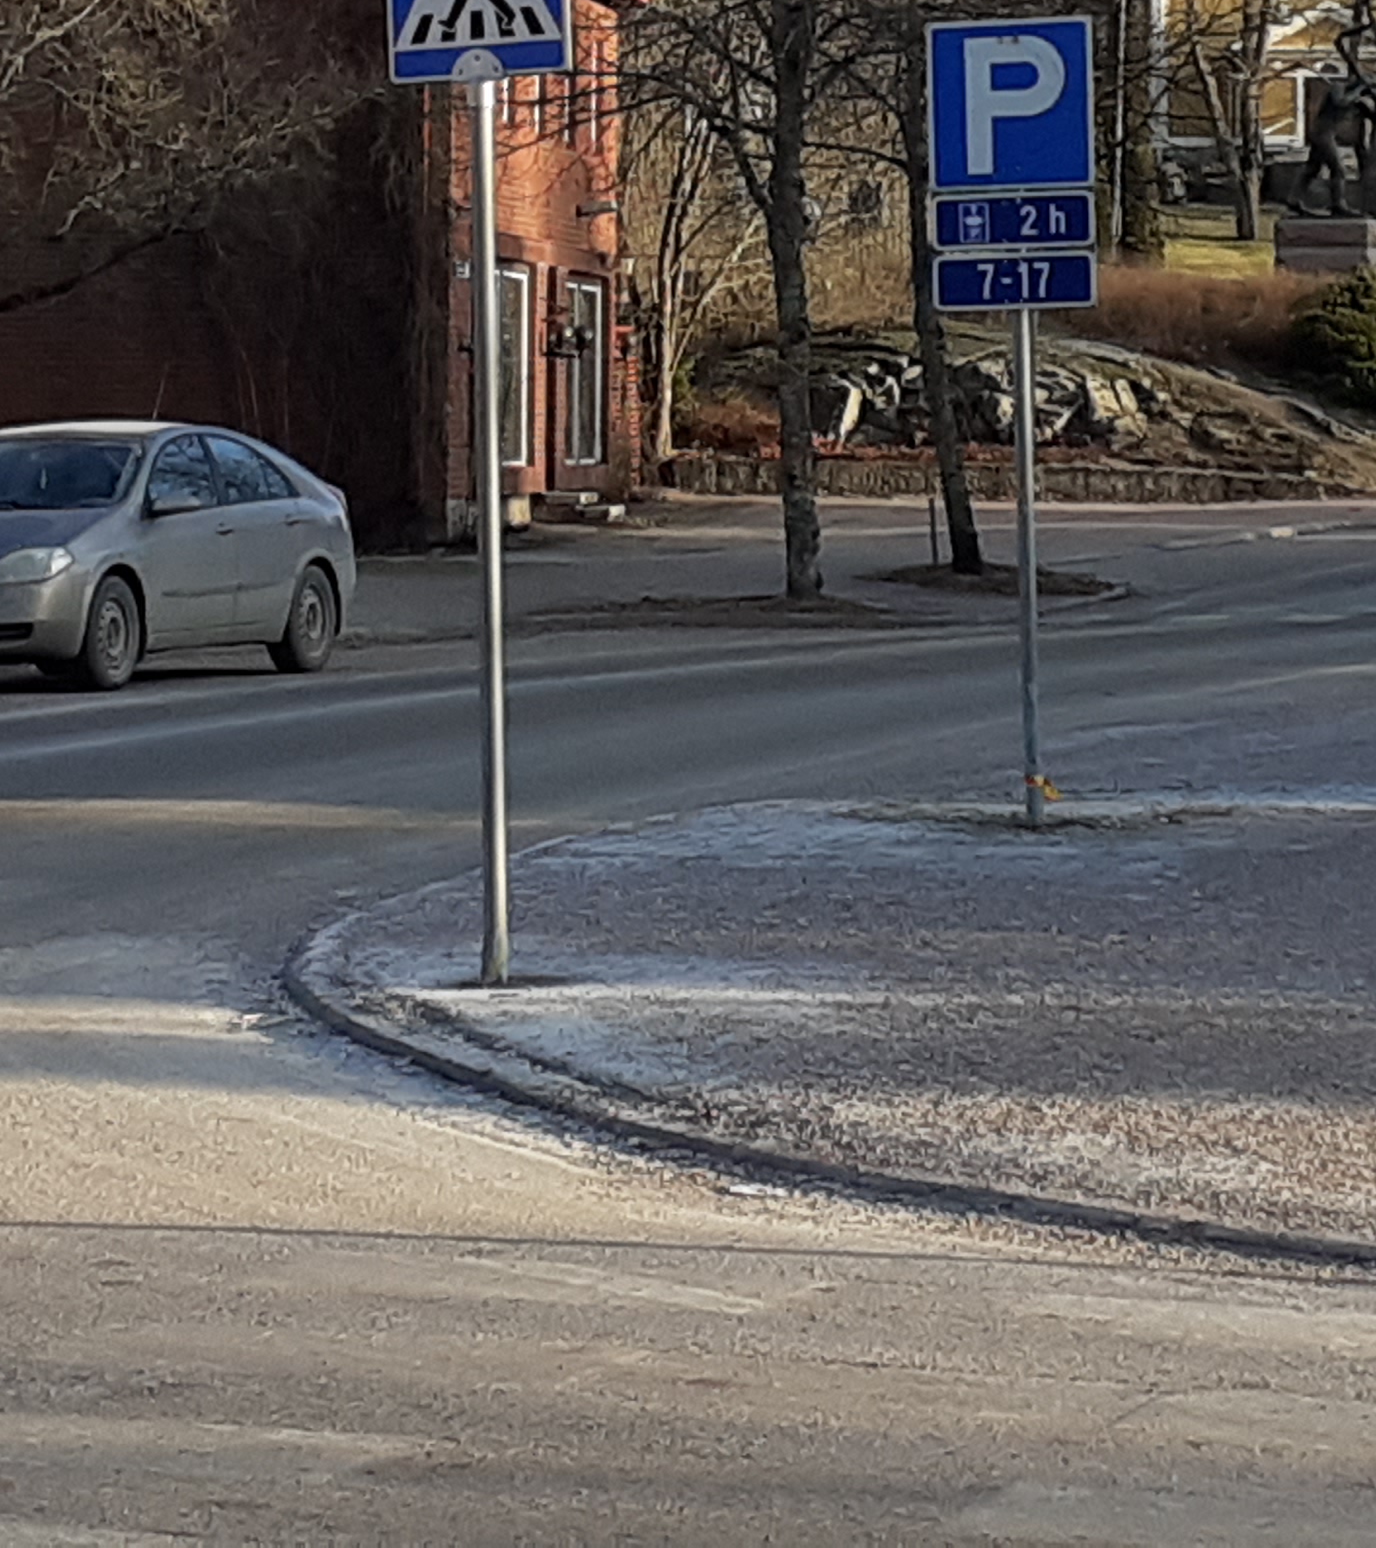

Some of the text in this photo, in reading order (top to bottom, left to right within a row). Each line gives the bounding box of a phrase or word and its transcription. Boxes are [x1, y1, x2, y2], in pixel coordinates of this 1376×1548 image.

[962, 34, 1066, 176] P
[1019, 203, 1066, 236] 2 h
[976, 261, 1052, 301] 7-17
